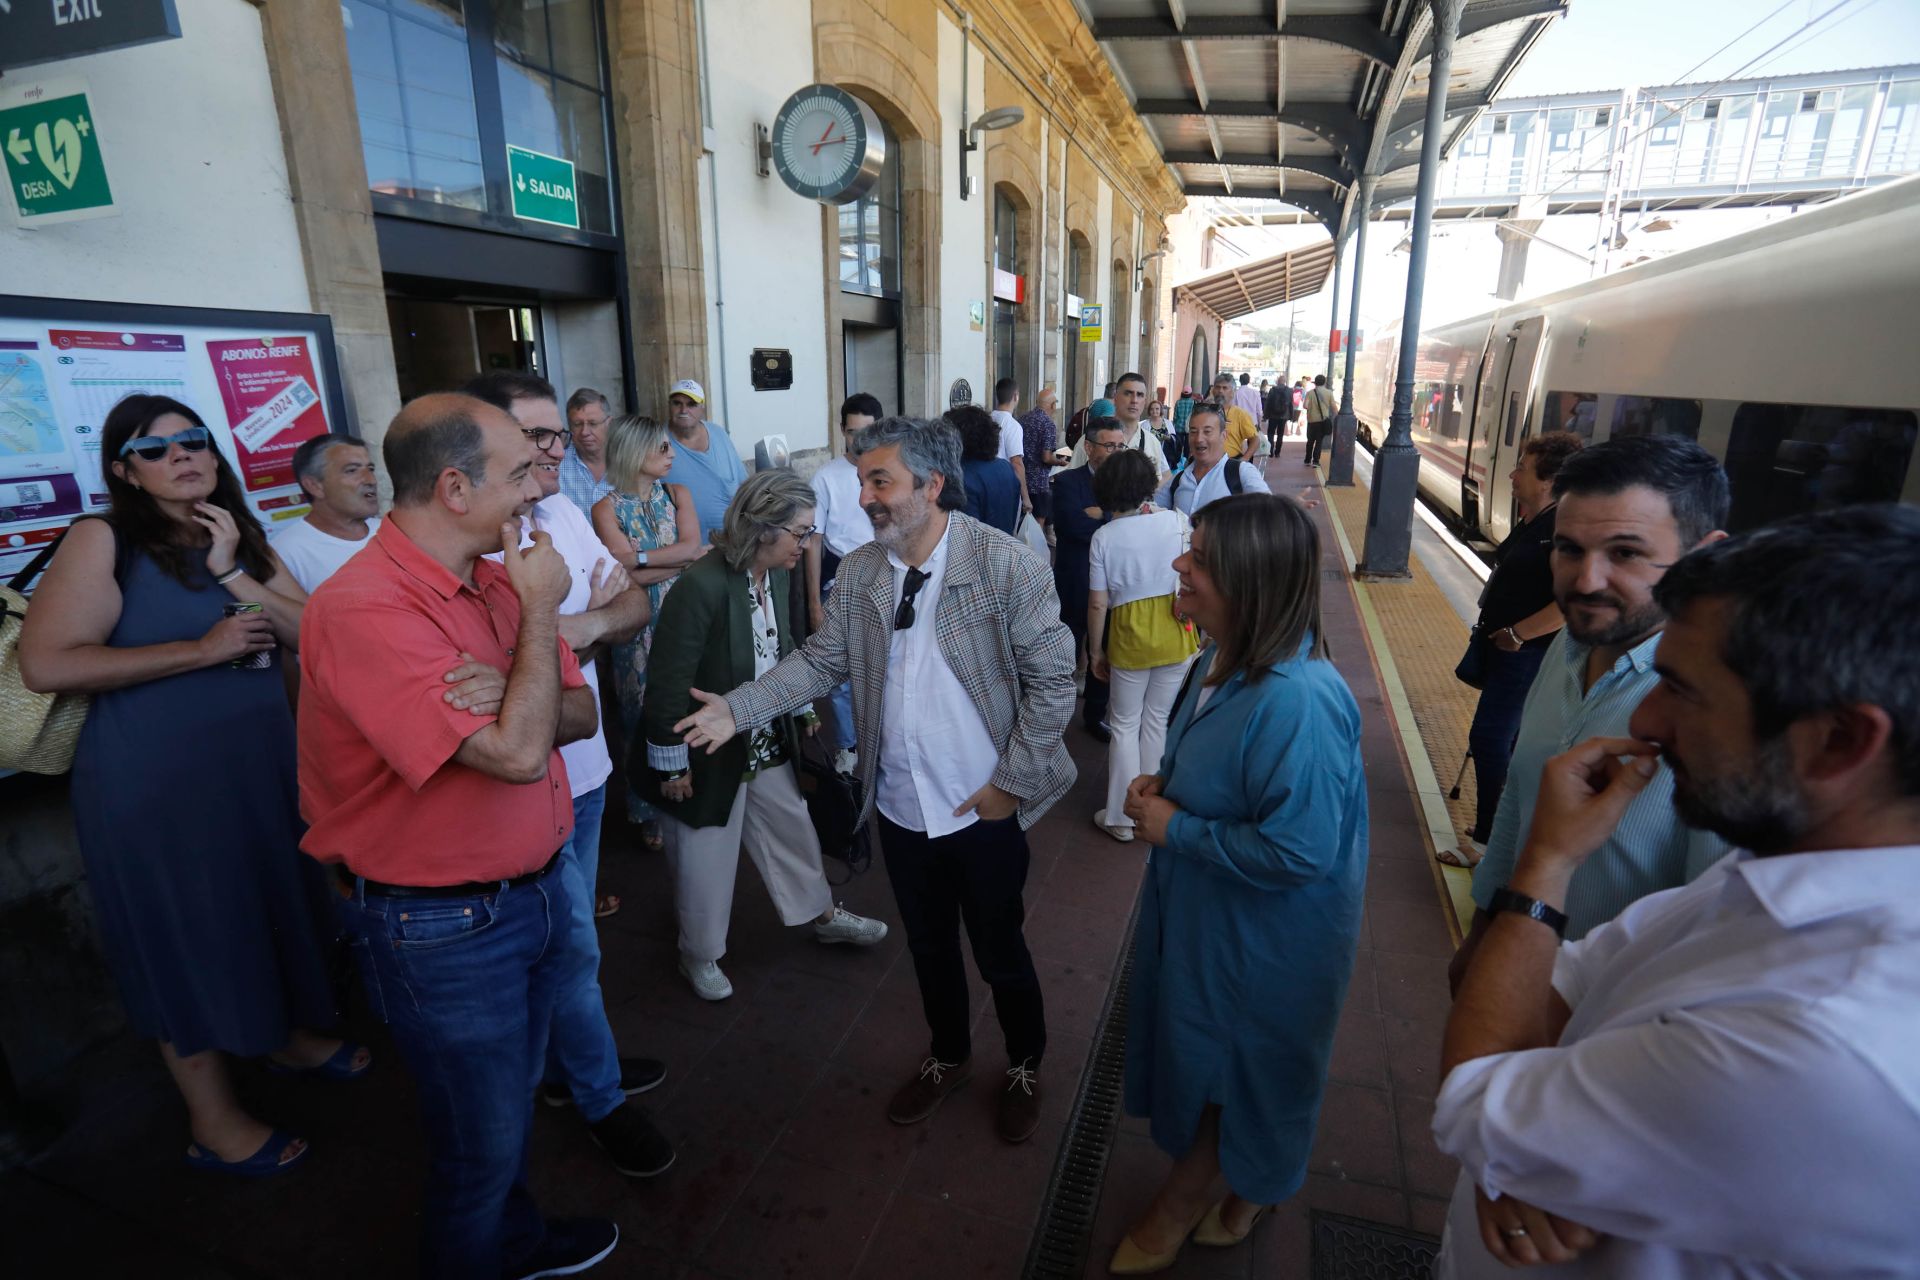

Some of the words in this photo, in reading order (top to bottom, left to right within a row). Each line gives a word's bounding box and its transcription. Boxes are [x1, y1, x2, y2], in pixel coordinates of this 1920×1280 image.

[24, 85, 44, 100] renfe
[21, 180, 57, 200] DESA
[529, 178, 574, 202] SALIDA
[221, 348, 267, 361] ABONOS
[269, 345, 301, 357] RENFE
[268, 395, 293, 418] 2024
